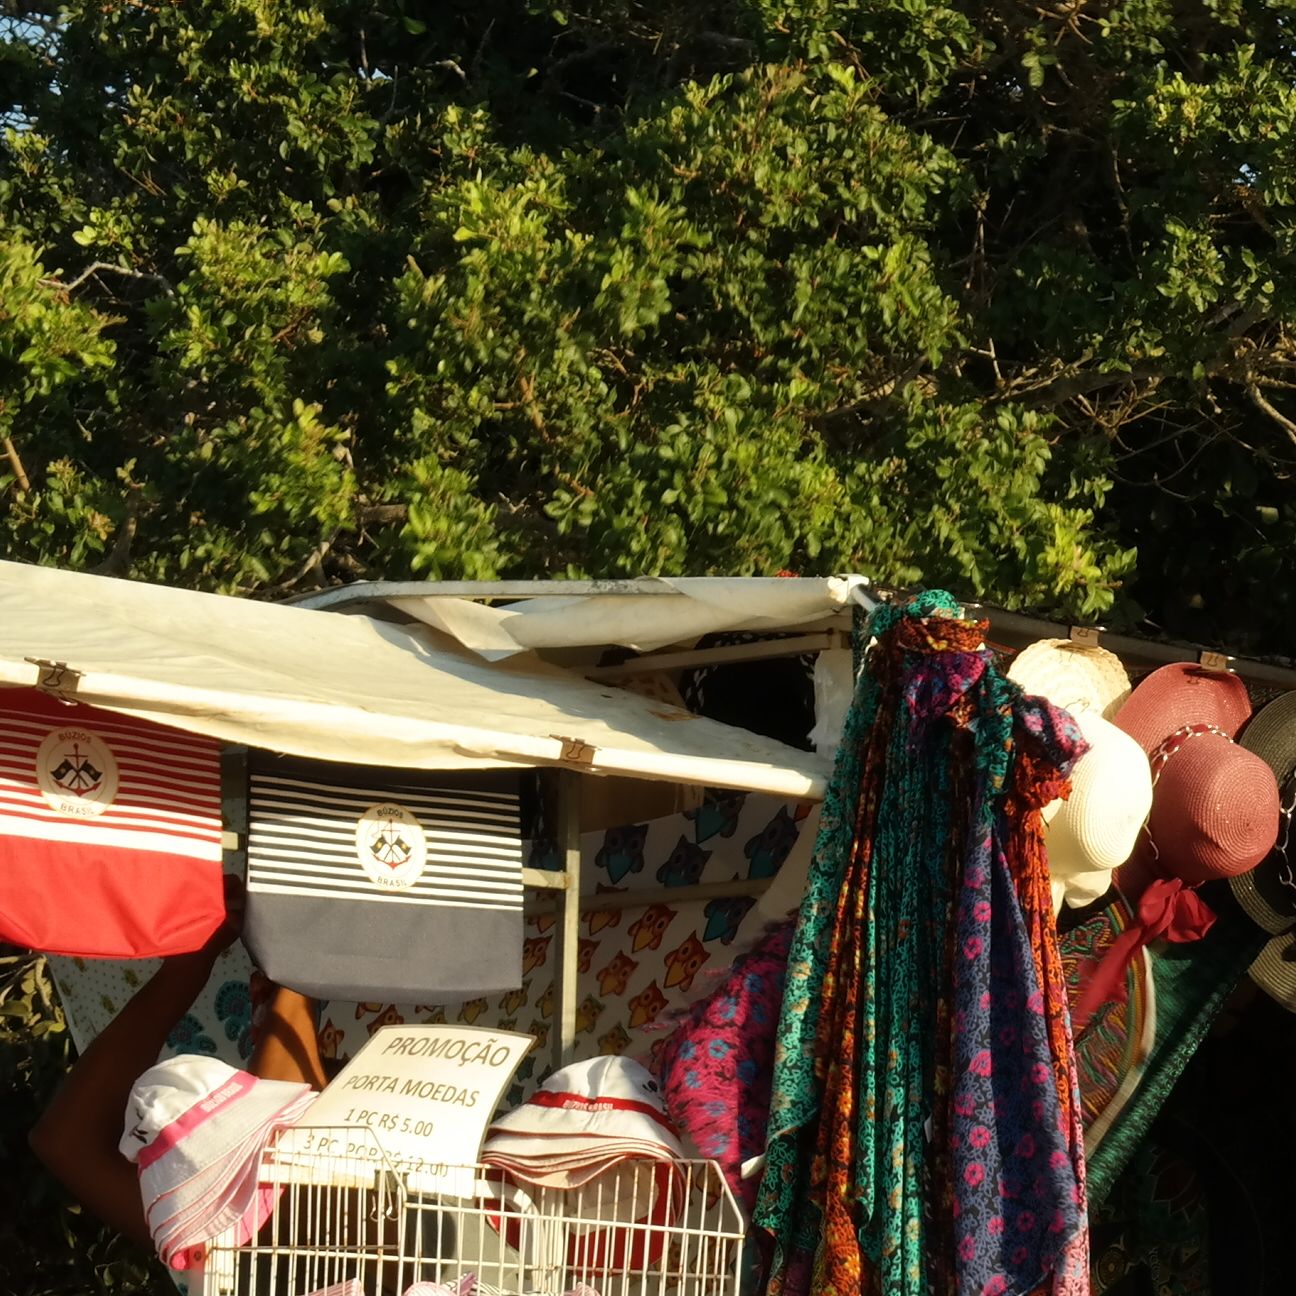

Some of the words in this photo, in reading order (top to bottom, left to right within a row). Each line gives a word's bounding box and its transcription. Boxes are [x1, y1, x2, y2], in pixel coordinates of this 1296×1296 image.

[381, 1037, 510, 1067] PROMOÇÃO
[342, 1075, 401, 1094] PORTA
[399, 1079, 480, 1107] MOEDAS
[344, 1108, 356, 1122] 1
[357, 1110, 379, 1126] PC
[378, 1113, 400, 1131] R$
[400, 1118, 434, 1137] 5.00
